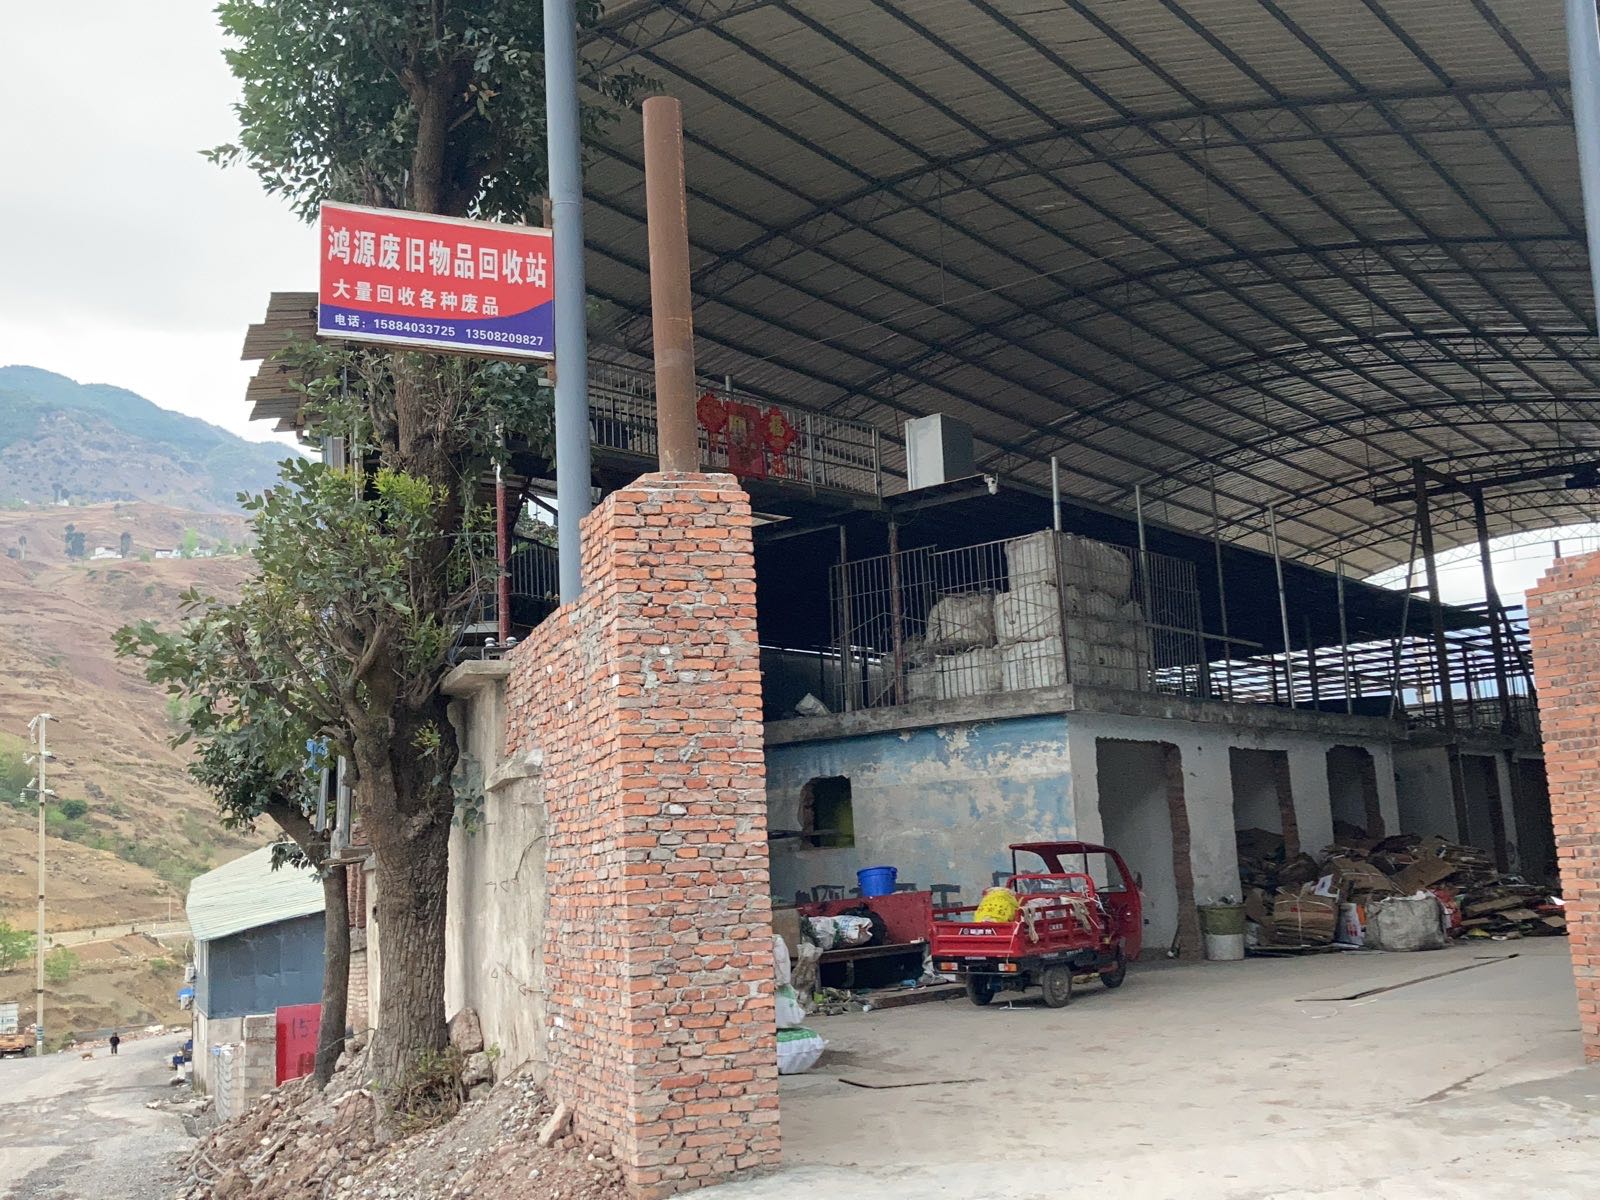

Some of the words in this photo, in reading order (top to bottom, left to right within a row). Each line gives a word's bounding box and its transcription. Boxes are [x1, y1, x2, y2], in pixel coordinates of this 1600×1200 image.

[327, 225, 547, 288] 鸿源废旧物品回收站
[332, 278, 499, 315] 大量回收各种废品
[465, 328, 544, 346] 13508209827
